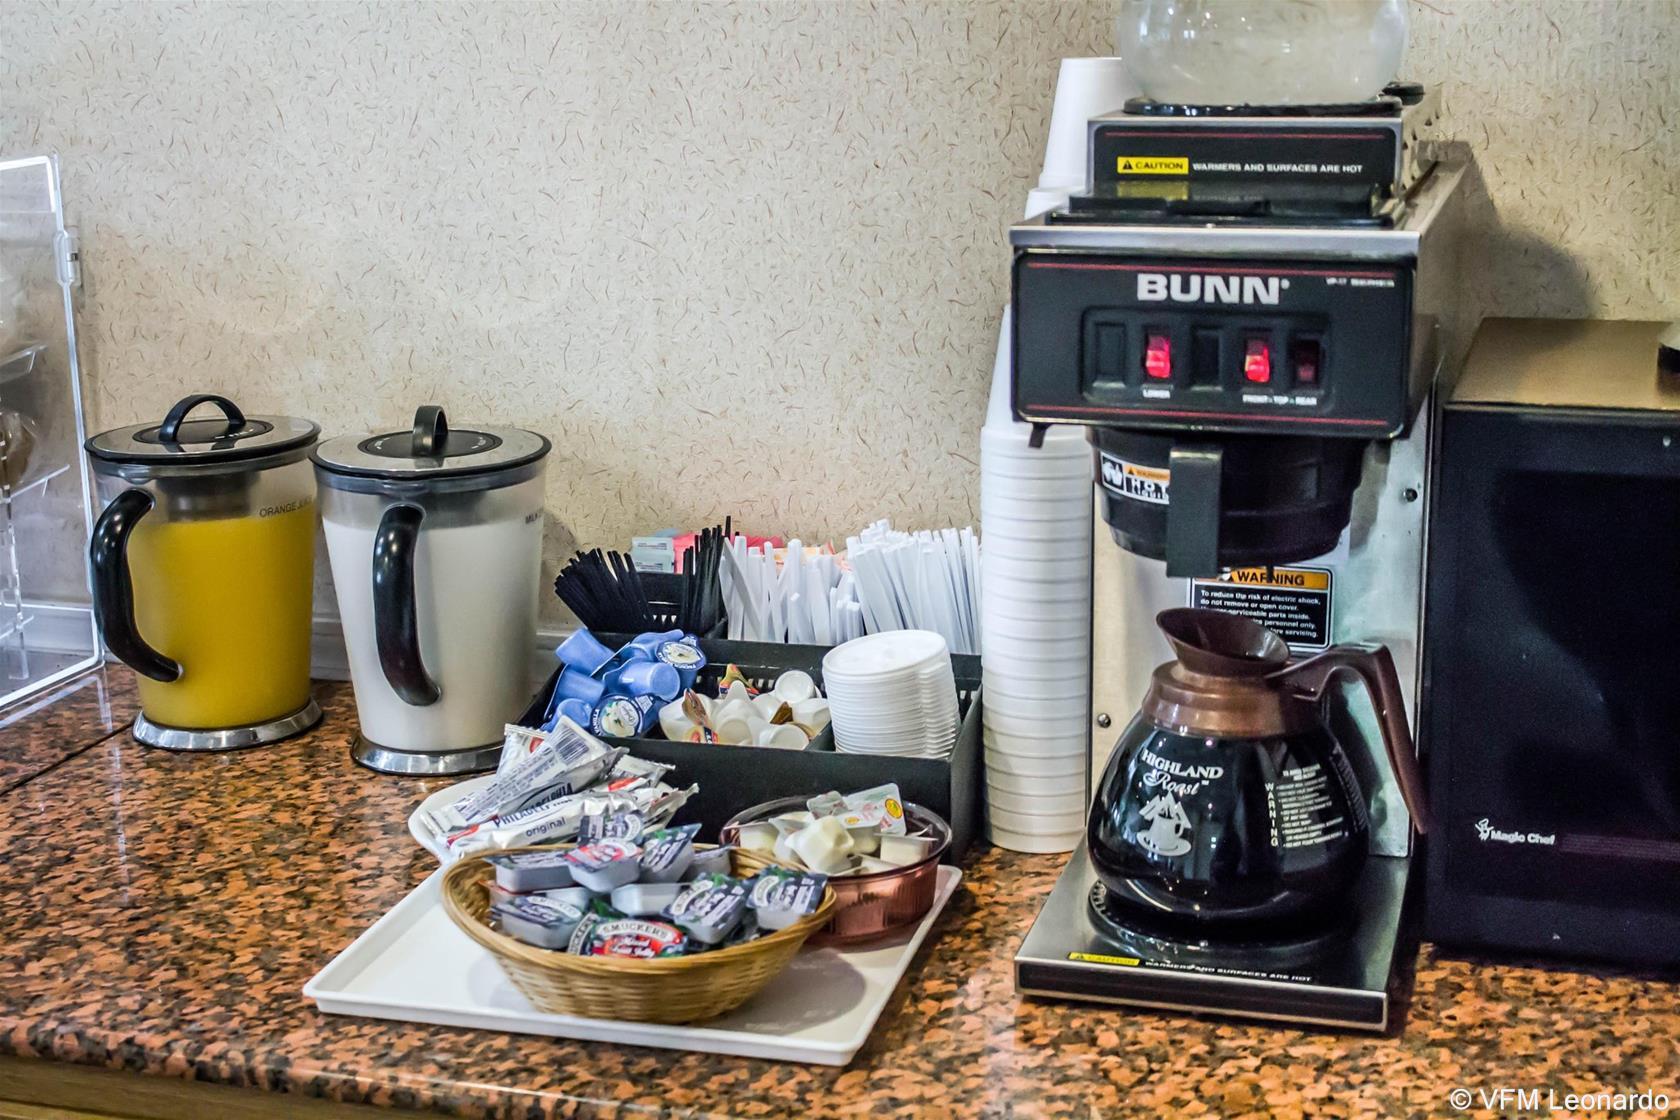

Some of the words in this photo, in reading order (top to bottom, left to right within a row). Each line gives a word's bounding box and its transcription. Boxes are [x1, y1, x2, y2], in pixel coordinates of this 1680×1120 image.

[1135, 162, 1184, 170] CAUTION
[1192, 163, 1241, 171] WARMERS
[1244, 163, 1264, 172] AND
[1267, 164, 1317, 172] SURFACES
[1320, 164, 1340, 173] ARE
[1343, 165, 1363, 173] HOT
[1137, 273, 1280, 305] BUNN
[259, 502, 297, 518] ORANGE
[1211, 590, 1234, 598] reduce
[1235, 591, 1247, 599] the
[1248, 592, 1260, 600] risk
[1262, 592, 1270, 600] of
[1271, 594, 1296, 603] electric
[1223, 600, 1249, 608] remove
[1259, 603, 1277, 611] open
[1264, 620, 1299, 628] personnel
[1141, 747, 1224, 779] HIGHLAND
[1143, 769, 1200, 796] Roast
[526, 817, 567, 838] original
[1490, 830, 1526, 843] Magic
[1527, 833, 1555, 845] Chef
